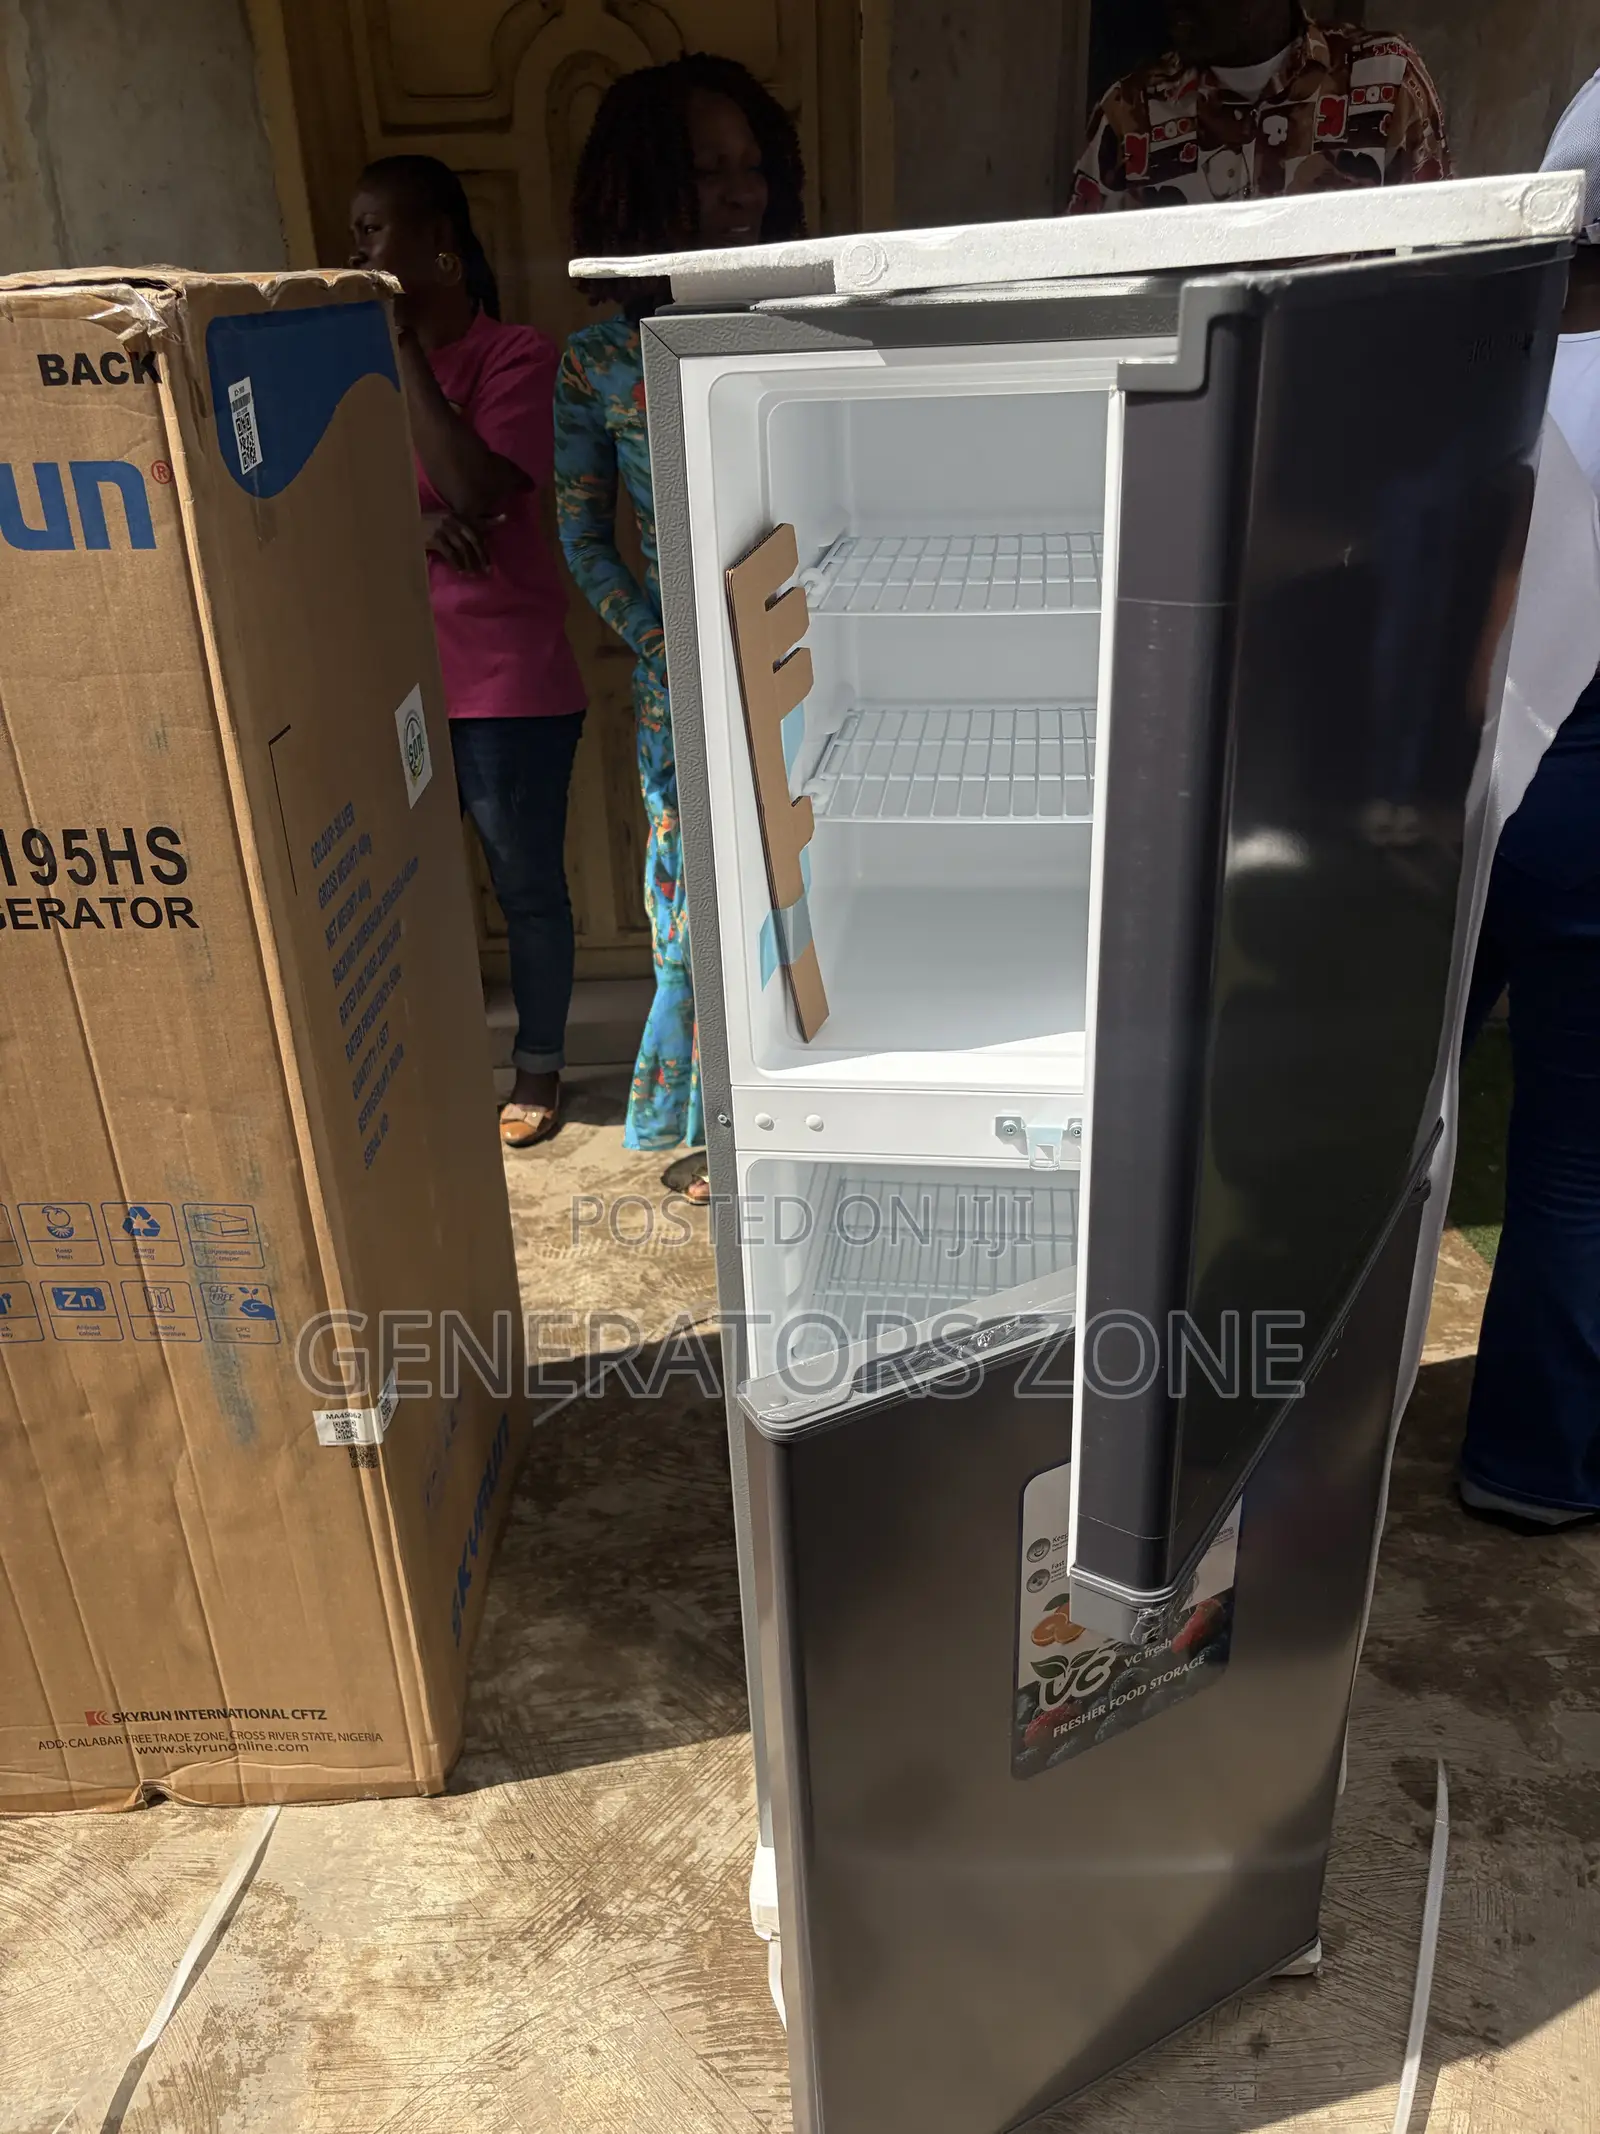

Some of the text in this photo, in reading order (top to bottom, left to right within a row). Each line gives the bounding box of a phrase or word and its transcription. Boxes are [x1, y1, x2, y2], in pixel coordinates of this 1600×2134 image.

[37, 351, 162, 386] BACK
[0, 897, 200, 929] ERATOR
[62, 1291, 97, 1308] Zn
[1124, 1639, 1172, 1667] VC fresh
[1053, 1655, 1205, 1737] FRESHER FOOD STORAGE
[112, 1707, 328, 1724] SKYRUN INTERNATIONAL CFTZ
[69, 1735, 123, 1748] CALABAR
[124, 1733, 152, 1744] FREE
[154, 1731, 191, 1743] TRADE
[194, 1731, 228, 1742] ZONE,
[229, 1731, 266, 1740] CROSS
[268, 1731, 299, 1741] RIVER
[302, 1731, 337, 1743] STATE,
[338, 1732, 383, 1742] NIGERIA
[135, 1741, 309, 1755] www.skyrunonline.com
